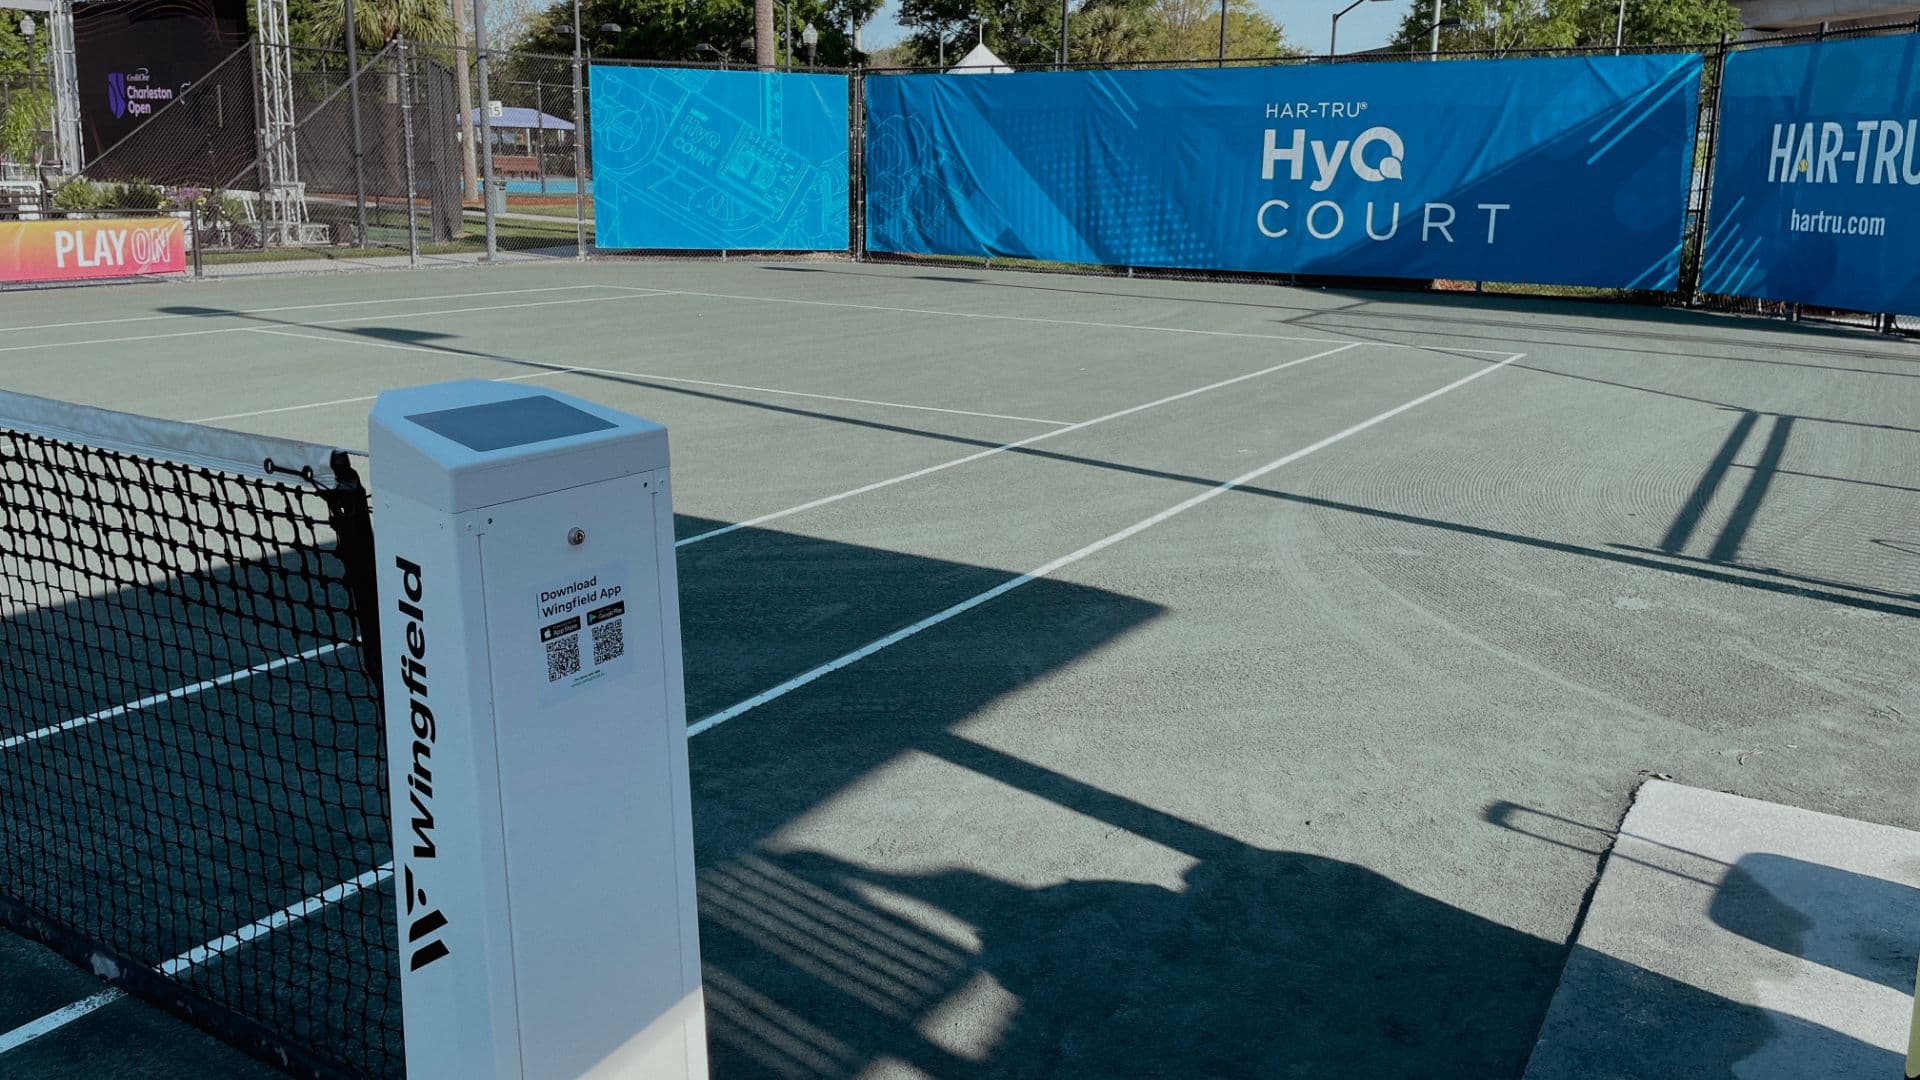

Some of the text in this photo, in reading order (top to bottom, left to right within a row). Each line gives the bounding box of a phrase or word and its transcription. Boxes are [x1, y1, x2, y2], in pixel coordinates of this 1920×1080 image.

[127, 85, 172, 99] Charleston
[128, 100, 151, 117] Open
[1261, 126, 1405, 192] HyQ
[1257, 199, 1511, 244] COURT
[1790, 208, 1886, 236] hartru.com
[54, 227, 172, 268] PLAY ON
[541, 576, 597, 602] Download
[542, 585, 622, 618] Wingfield App
